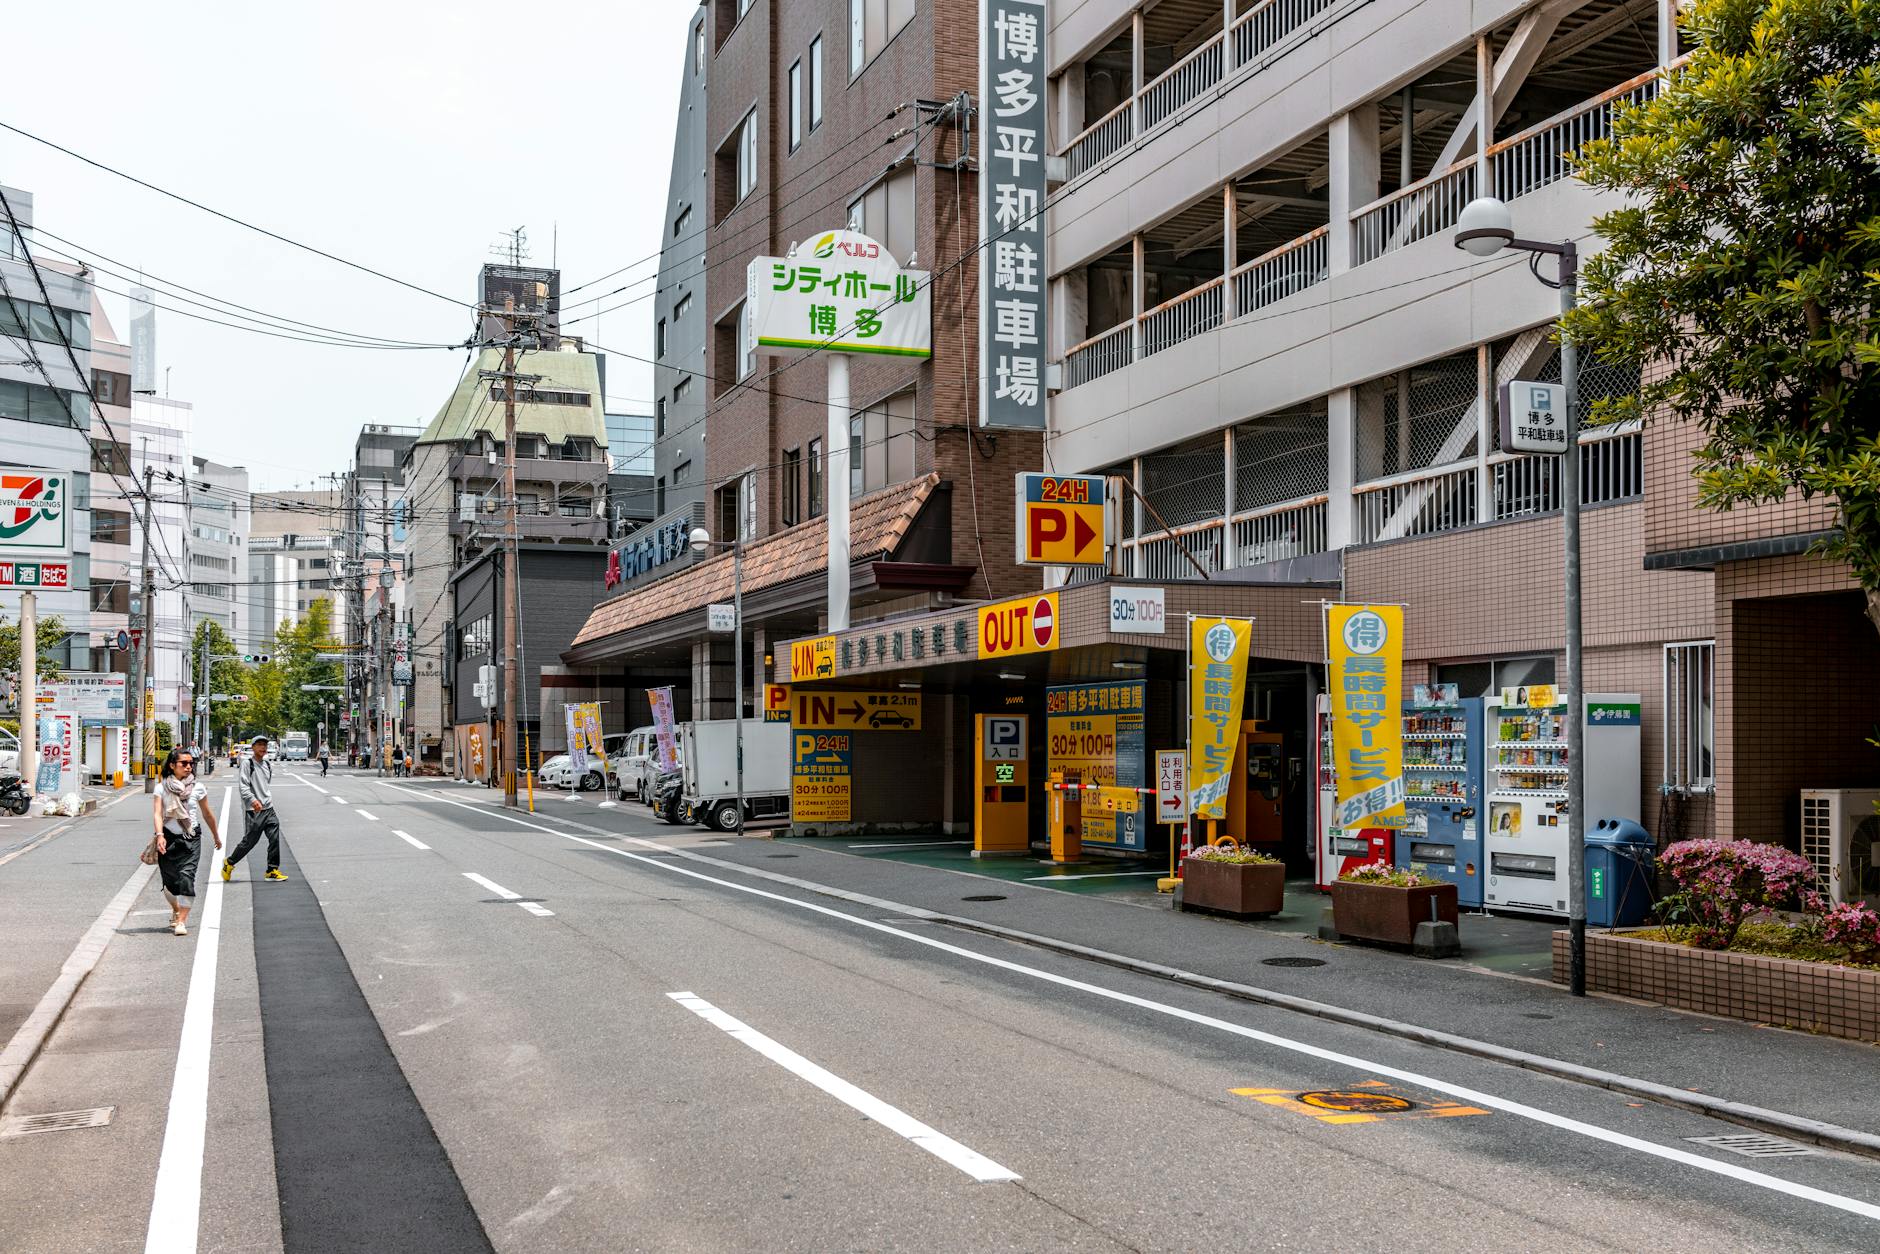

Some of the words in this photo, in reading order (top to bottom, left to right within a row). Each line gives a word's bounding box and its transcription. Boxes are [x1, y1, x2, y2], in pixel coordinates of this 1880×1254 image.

[994, 10, 1039, 407] 博多平和駐車場
[837, 241, 879, 259] ベルコ
[773, 264, 917, 303] シティホール
[809, 304, 883, 338] 博多
[1528, 411, 1555, 425] 博多
[1518, 427, 1565, 443] 平和駐車場
[1041, 477, 1089, 503] 24H
[1030, 507, 1067, 558] P
[19, 566, 36, 582] 酒
[42, 567, 66, 583] たばこ
[984, 606, 1028, 653] OUT
[1350, 616, 1381, 648] 得
[841, 620, 968, 669] 博多平和駐車場
[1209, 629, 1231, 657] 得
[802, 644, 814, 676] IN
[770, 687, 787, 709] P
[799, 695, 835, 725] IN
[1068, 686, 1143, 712] 博多平和駐車場
[767, 711, 779, 721] IN
[1203, 664, 1234, 775] 長時間サービス
[1342, 657, 1391, 781] 長時間サービス
[1606, 709, 1631, 719] 伊藤園
[817, 734, 849, 752] 24H
[994, 721, 1017, 743] P
[796, 734, 816, 763] P
[992, 747, 1019, 758] 入口
[995, 764, 1014, 783] 空
[1161, 757, 1171, 791] 出入口
[1173, 757, 1183, 790] 利用者
[1116, 800, 1132, 810] 出口
[1373, 816, 1407, 827] AMS
